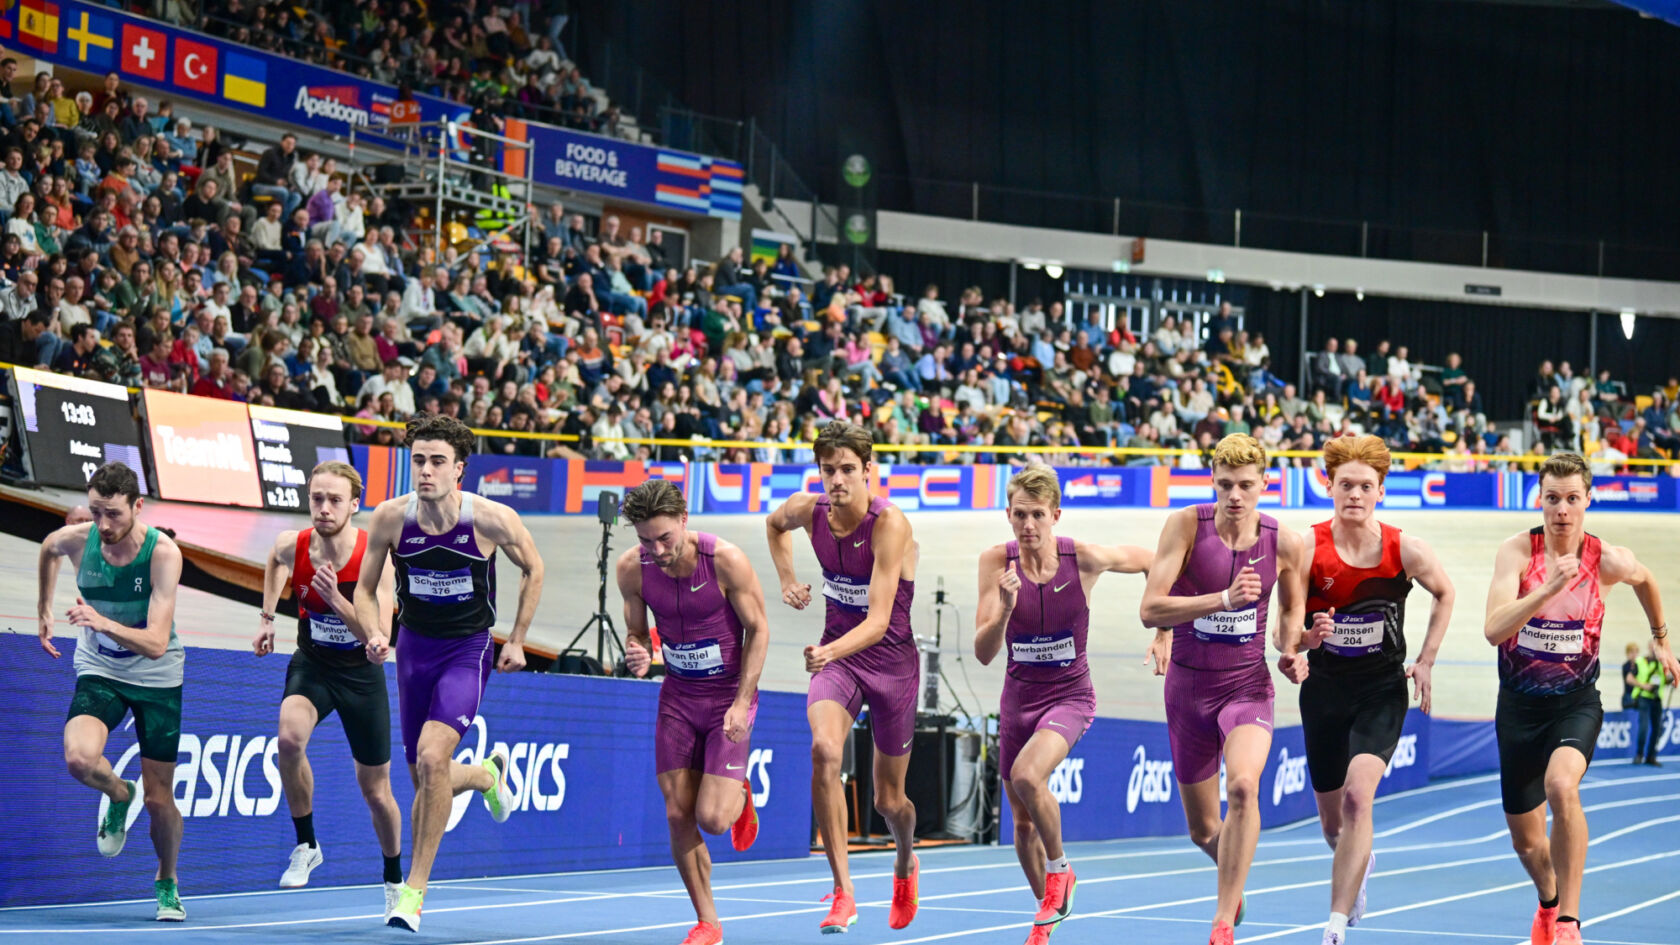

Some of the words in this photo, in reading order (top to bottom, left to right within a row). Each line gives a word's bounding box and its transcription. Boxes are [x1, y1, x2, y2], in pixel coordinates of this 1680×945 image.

[566, 142, 607, 165] FOOD
[607, 150, 618, 168] &
[555, 158, 628, 188] BEVERAGE
[414, 576, 467, 586] Scheltema
[839, 593, 854, 603] 315
[1215, 624, 1234, 633] 124
[1333, 625, 1374, 635] Janssen
[1520, 626, 1582, 641] Anderiessen
[329, 634, 345, 642] 492
[1343, 636, 1362, 645] 204
[1013, 640, 1072, 653] Verbaandert
[1543, 642, 1557, 651] 12
[670, 651, 687, 660] van
[688, 650, 709, 660] Riel
[681, 661, 699, 669] 357
